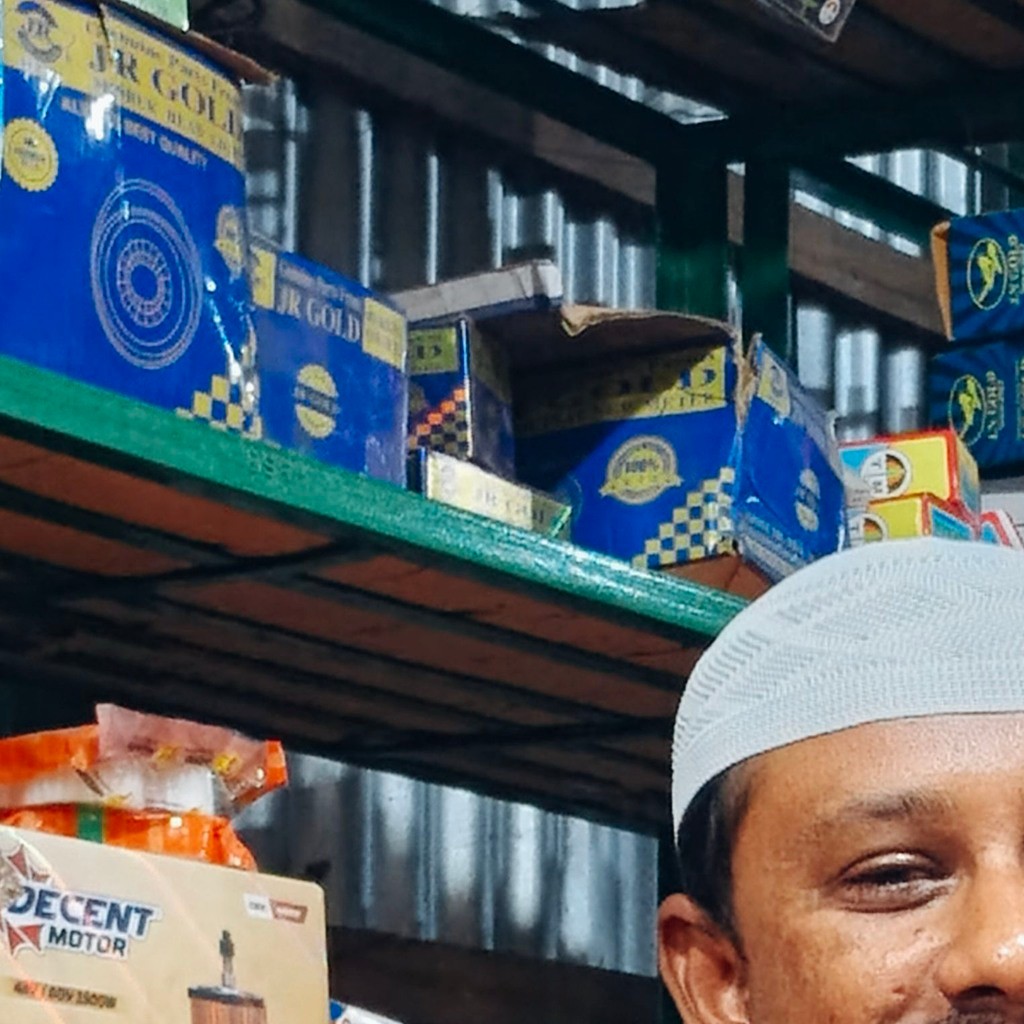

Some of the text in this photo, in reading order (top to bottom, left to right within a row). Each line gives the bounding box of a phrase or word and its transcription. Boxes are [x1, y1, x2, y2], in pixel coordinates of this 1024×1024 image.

[306, 298, 361, 343] GOLD
[8, 886, 154, 936] DECENT
[49, 925, 126, 957] MOTOR
